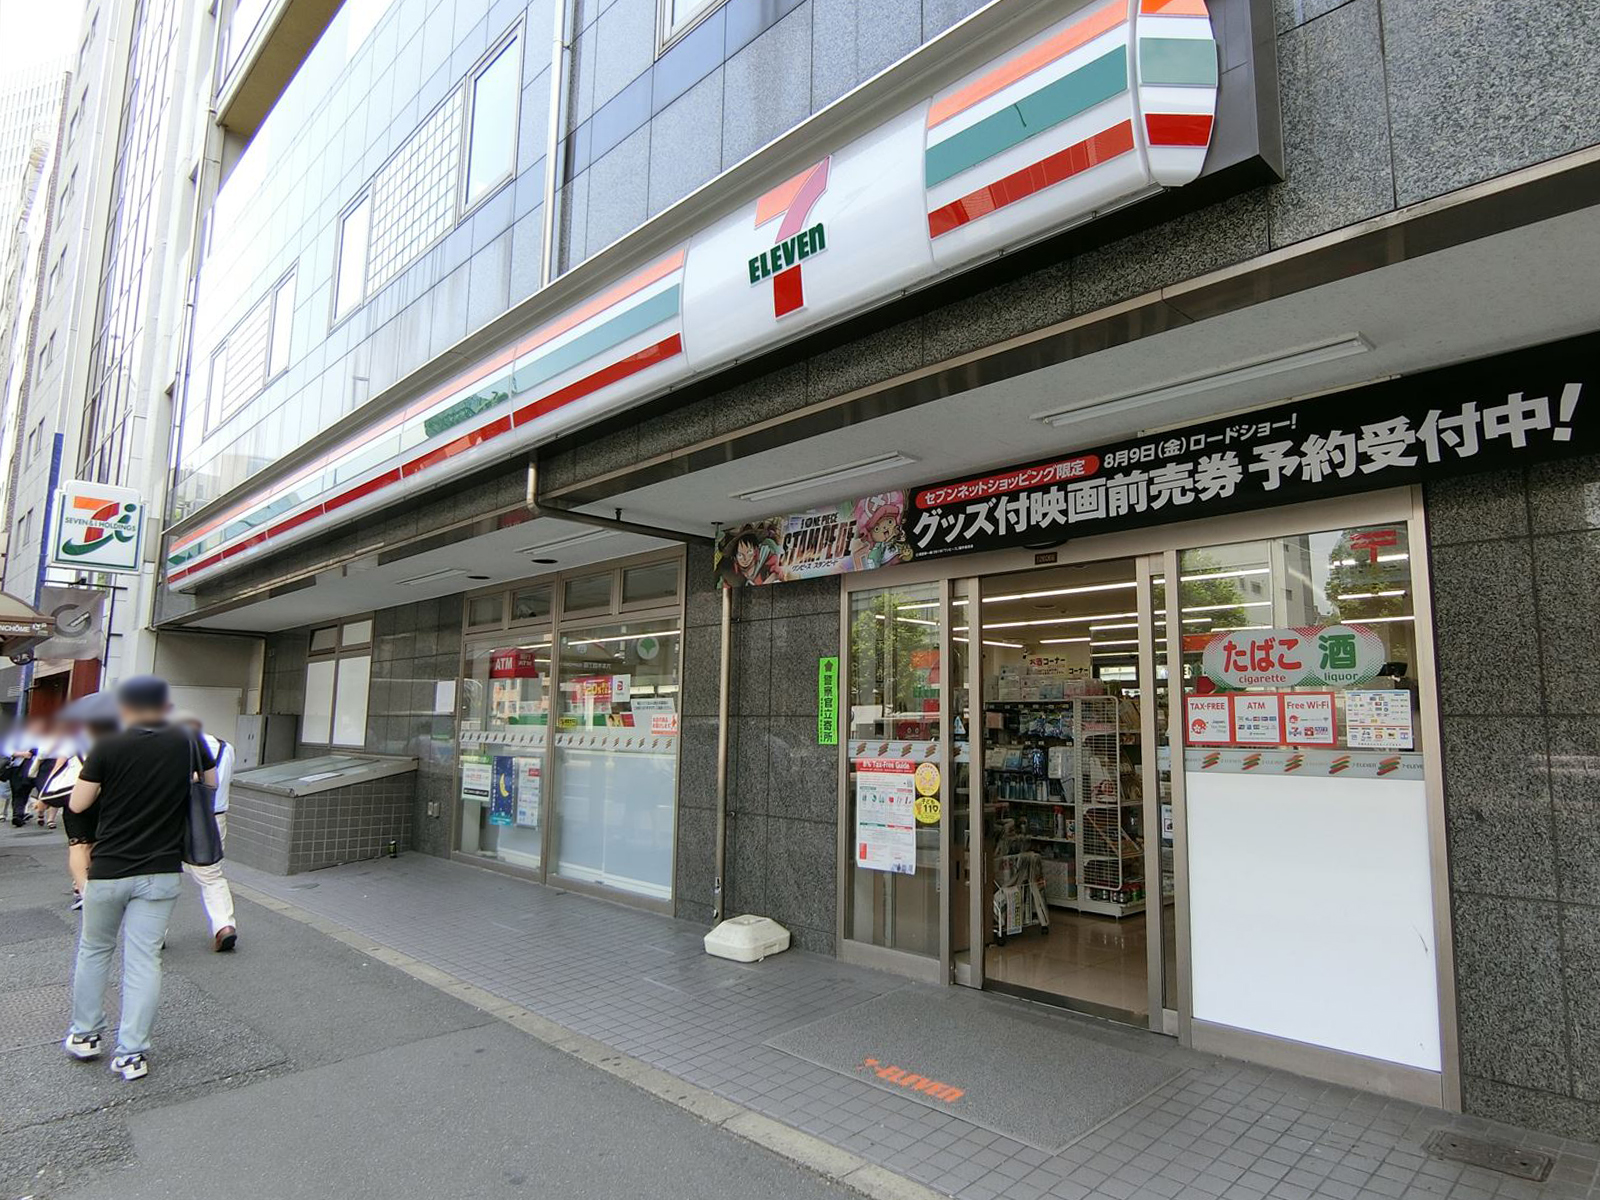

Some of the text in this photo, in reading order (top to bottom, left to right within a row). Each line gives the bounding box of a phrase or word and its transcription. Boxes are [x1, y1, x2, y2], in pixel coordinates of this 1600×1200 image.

[912, 382, 1583, 549] グッズ付映画前売券 予約受付中!
[924, 459, 1086, 506] セブンネットショッピング限定
[1223, 637, 1302, 673] たばこ
[1318, 633, 1357, 670] 酒
[495, 656, 513, 671] ATM
[1238, 674, 1287, 684] cigarette
[1323, 672, 1359, 682] liquor
[1190, 702, 1225, 710] TAX-FREE
[1247, 702, 1266, 710] ATM
[1287, 701, 1329, 709] Free Wi-Fi
